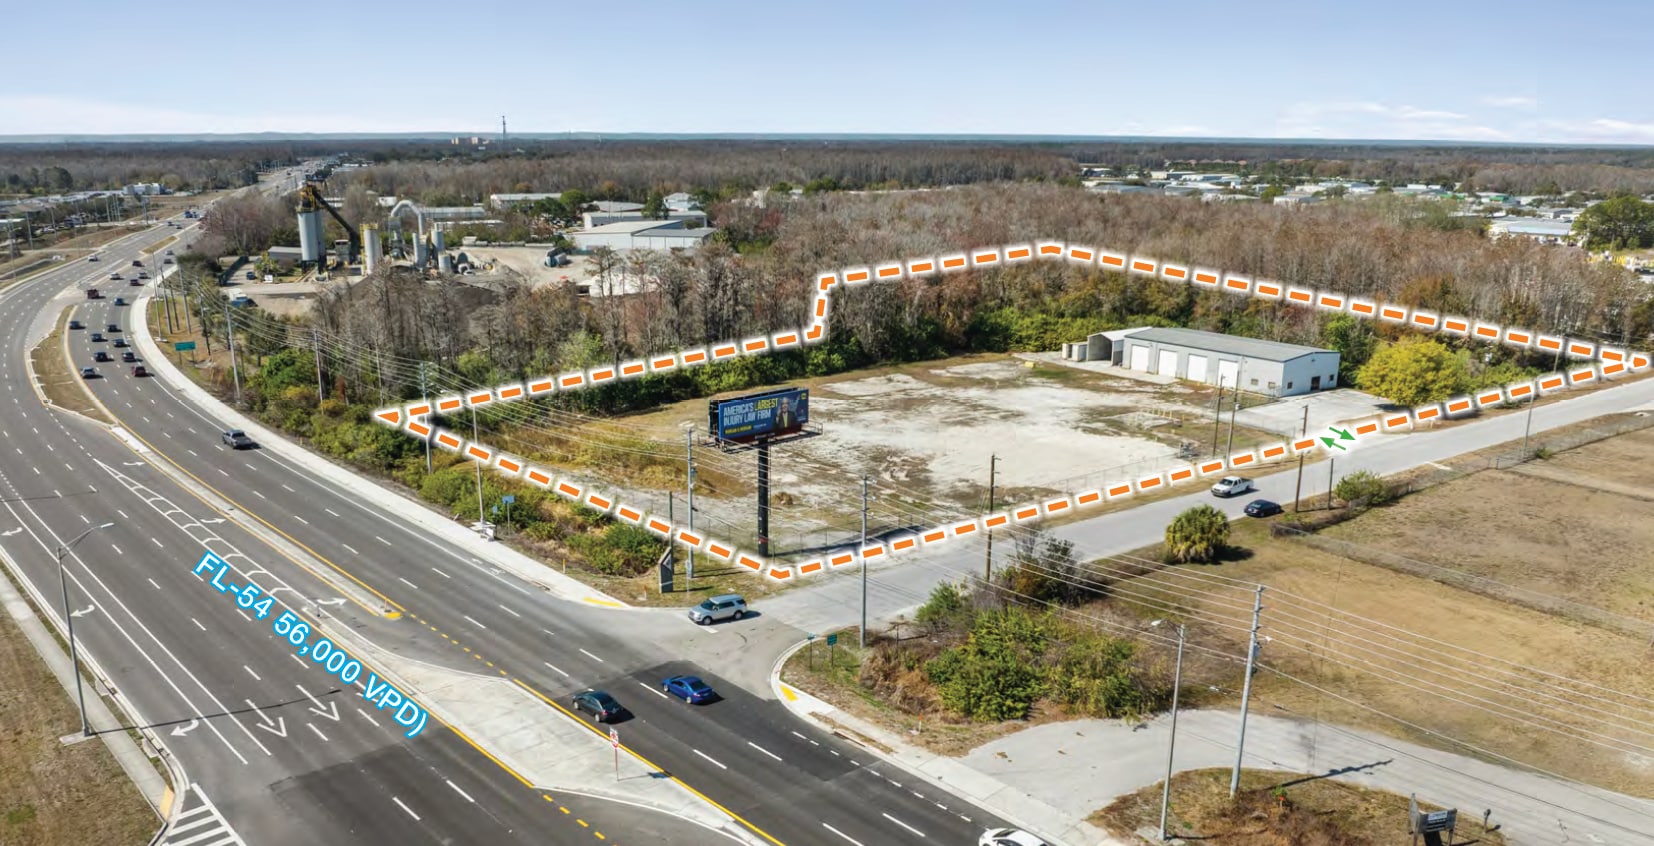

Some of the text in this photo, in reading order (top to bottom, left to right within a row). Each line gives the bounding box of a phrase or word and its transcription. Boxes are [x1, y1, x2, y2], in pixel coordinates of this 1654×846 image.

[724, 398, 778, 417] AMERICA'S LARGEST
[724, 413, 743, 427] INJURY
[743, 411, 756, 422] LAW
[758, 409, 771, 420] FIRM
